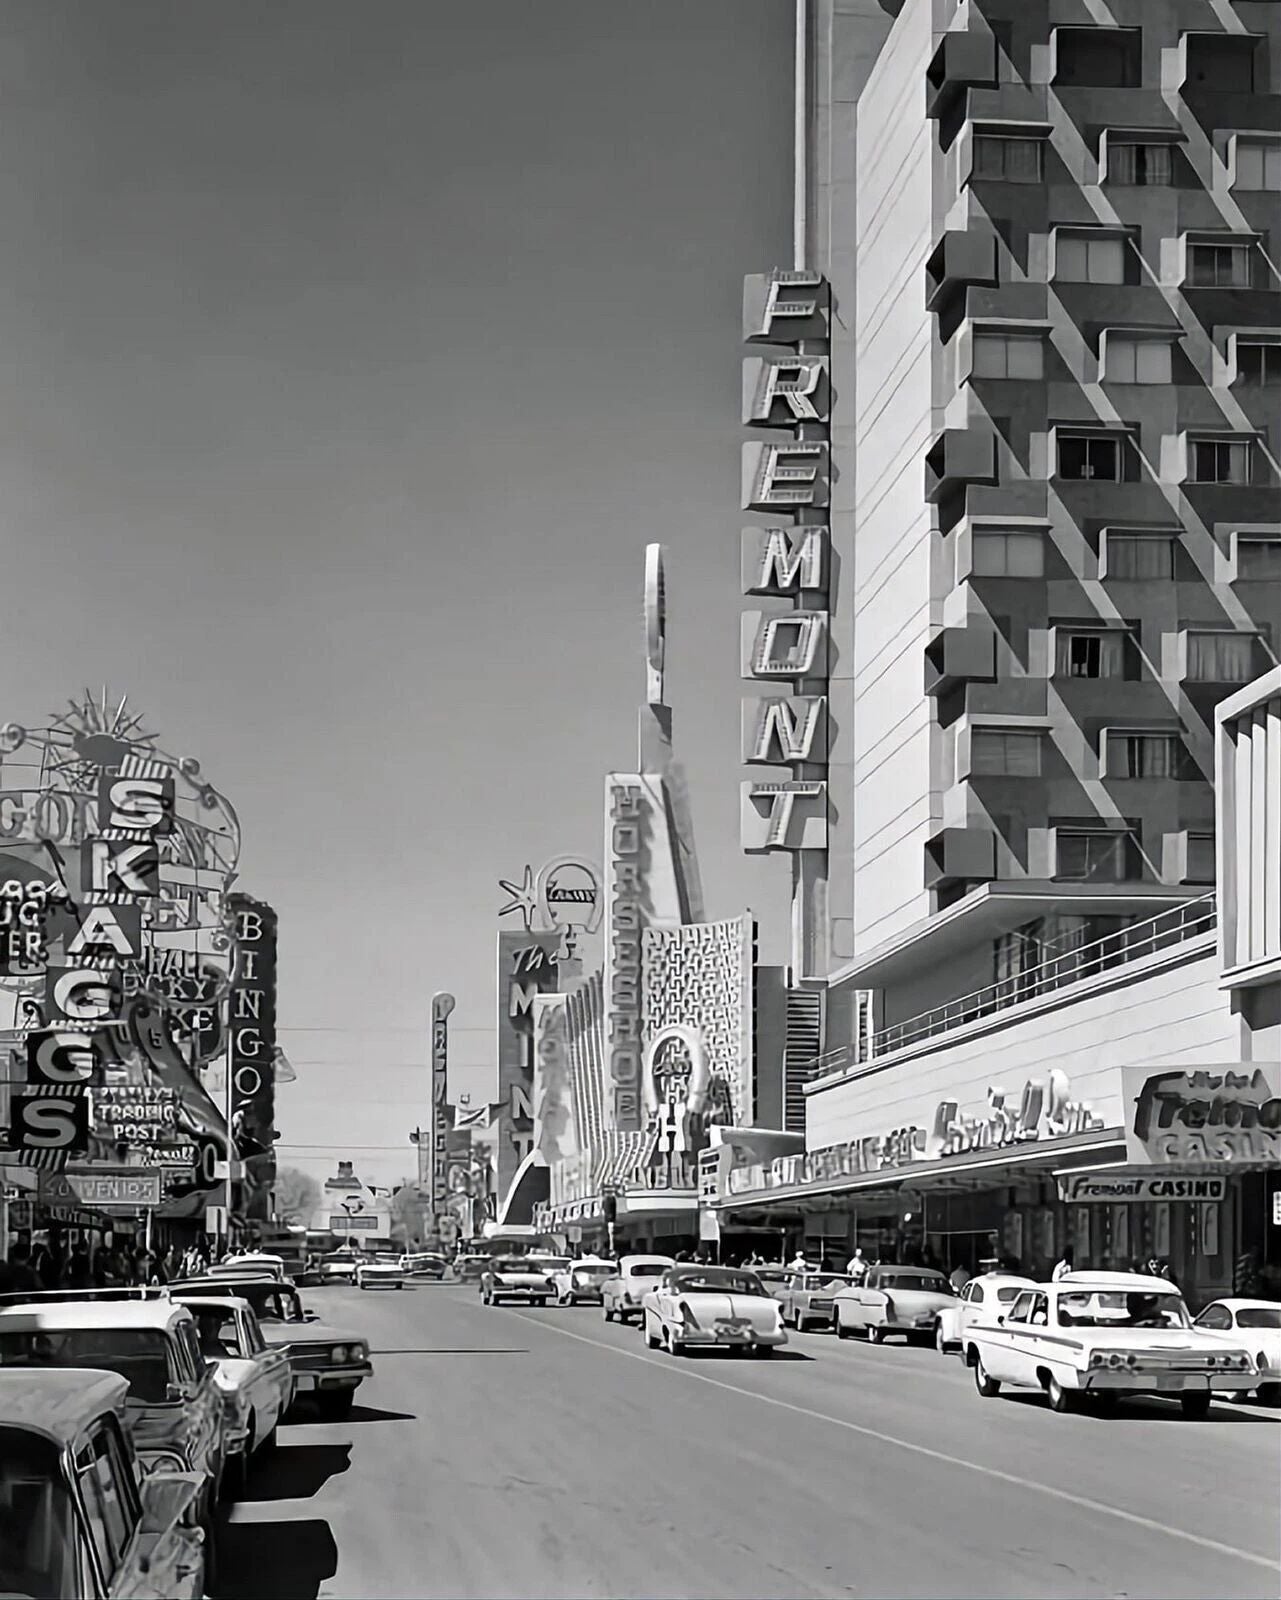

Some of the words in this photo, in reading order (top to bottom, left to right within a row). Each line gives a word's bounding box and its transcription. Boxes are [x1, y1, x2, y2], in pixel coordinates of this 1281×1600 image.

[750, 268, 827, 848] FREMONT
[22, 780, 165, 1147] SKAGGS
[234, 910, 265, 1095] BINGO
[512, 943, 559, 976] The
[609, 785, 641, 1125] HORSESHOE
[112, 1123, 162, 1140] POST
[1072, 1176, 1145, 1199] Fremont
[1149, 1180, 1222, 1197] CASINO
